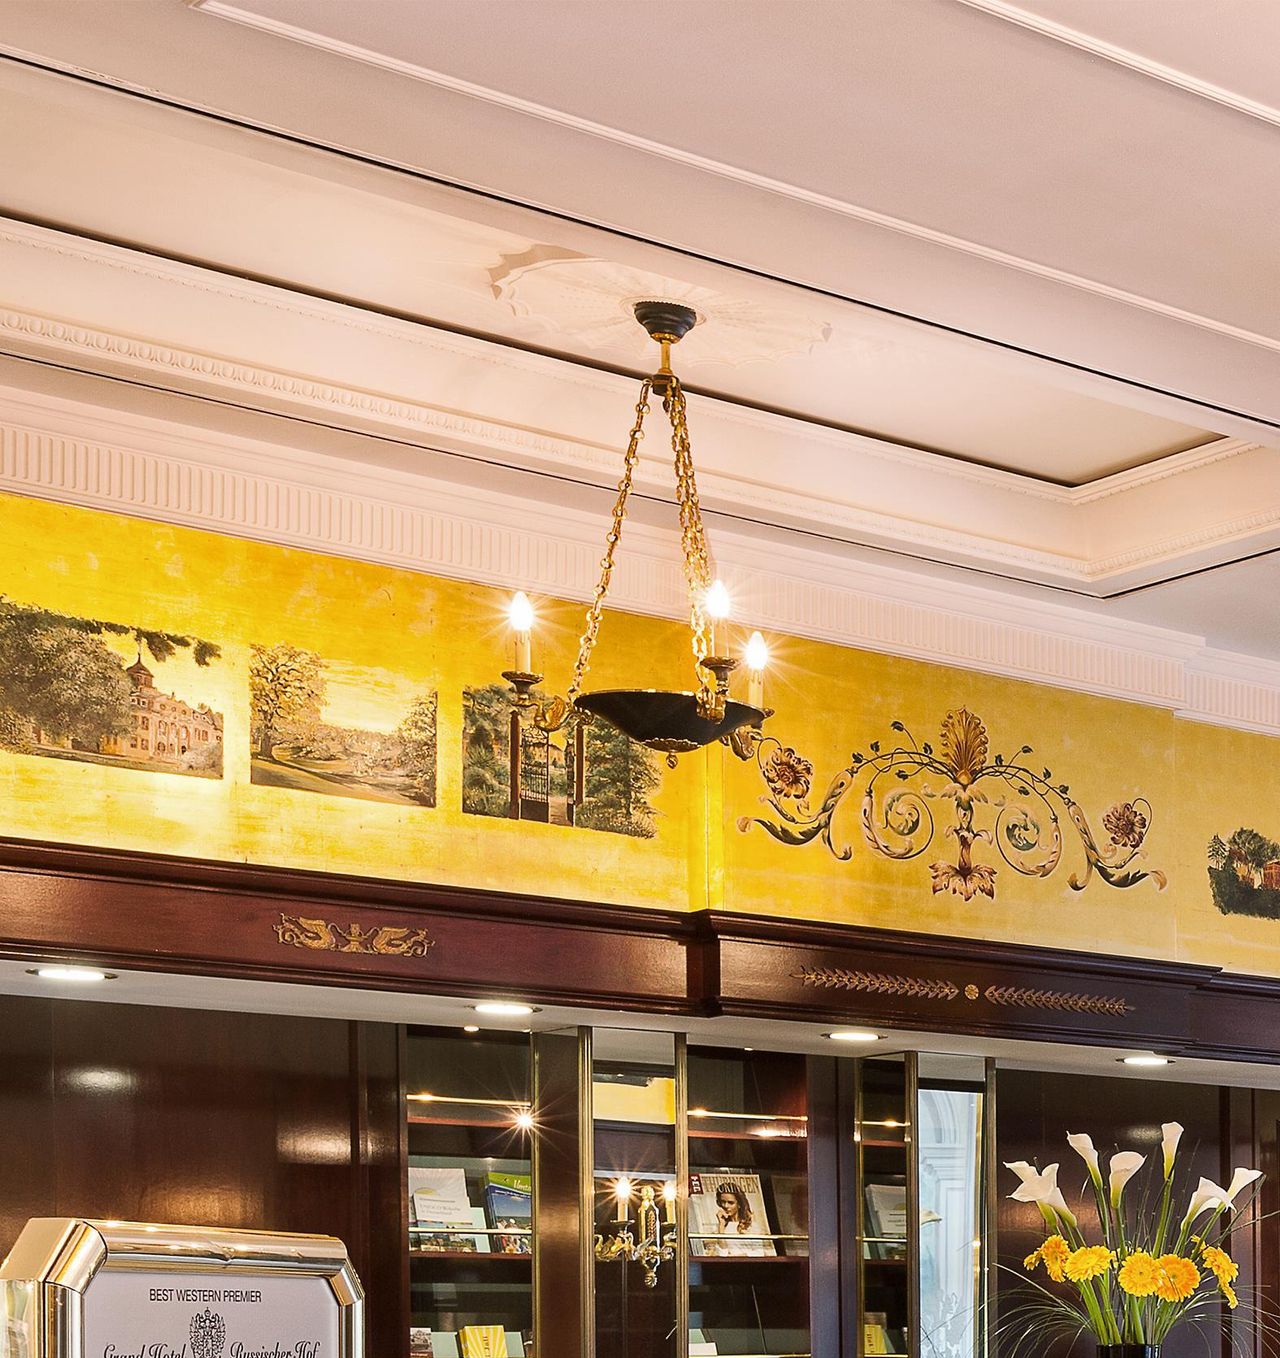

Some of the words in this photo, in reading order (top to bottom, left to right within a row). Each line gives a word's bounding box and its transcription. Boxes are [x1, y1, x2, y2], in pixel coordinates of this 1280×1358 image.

[149, 1288, 176, 1302] BEST
[176, 1288, 222, 1303] WESTERN
[223, 1289, 262, 1303] PREMIER
